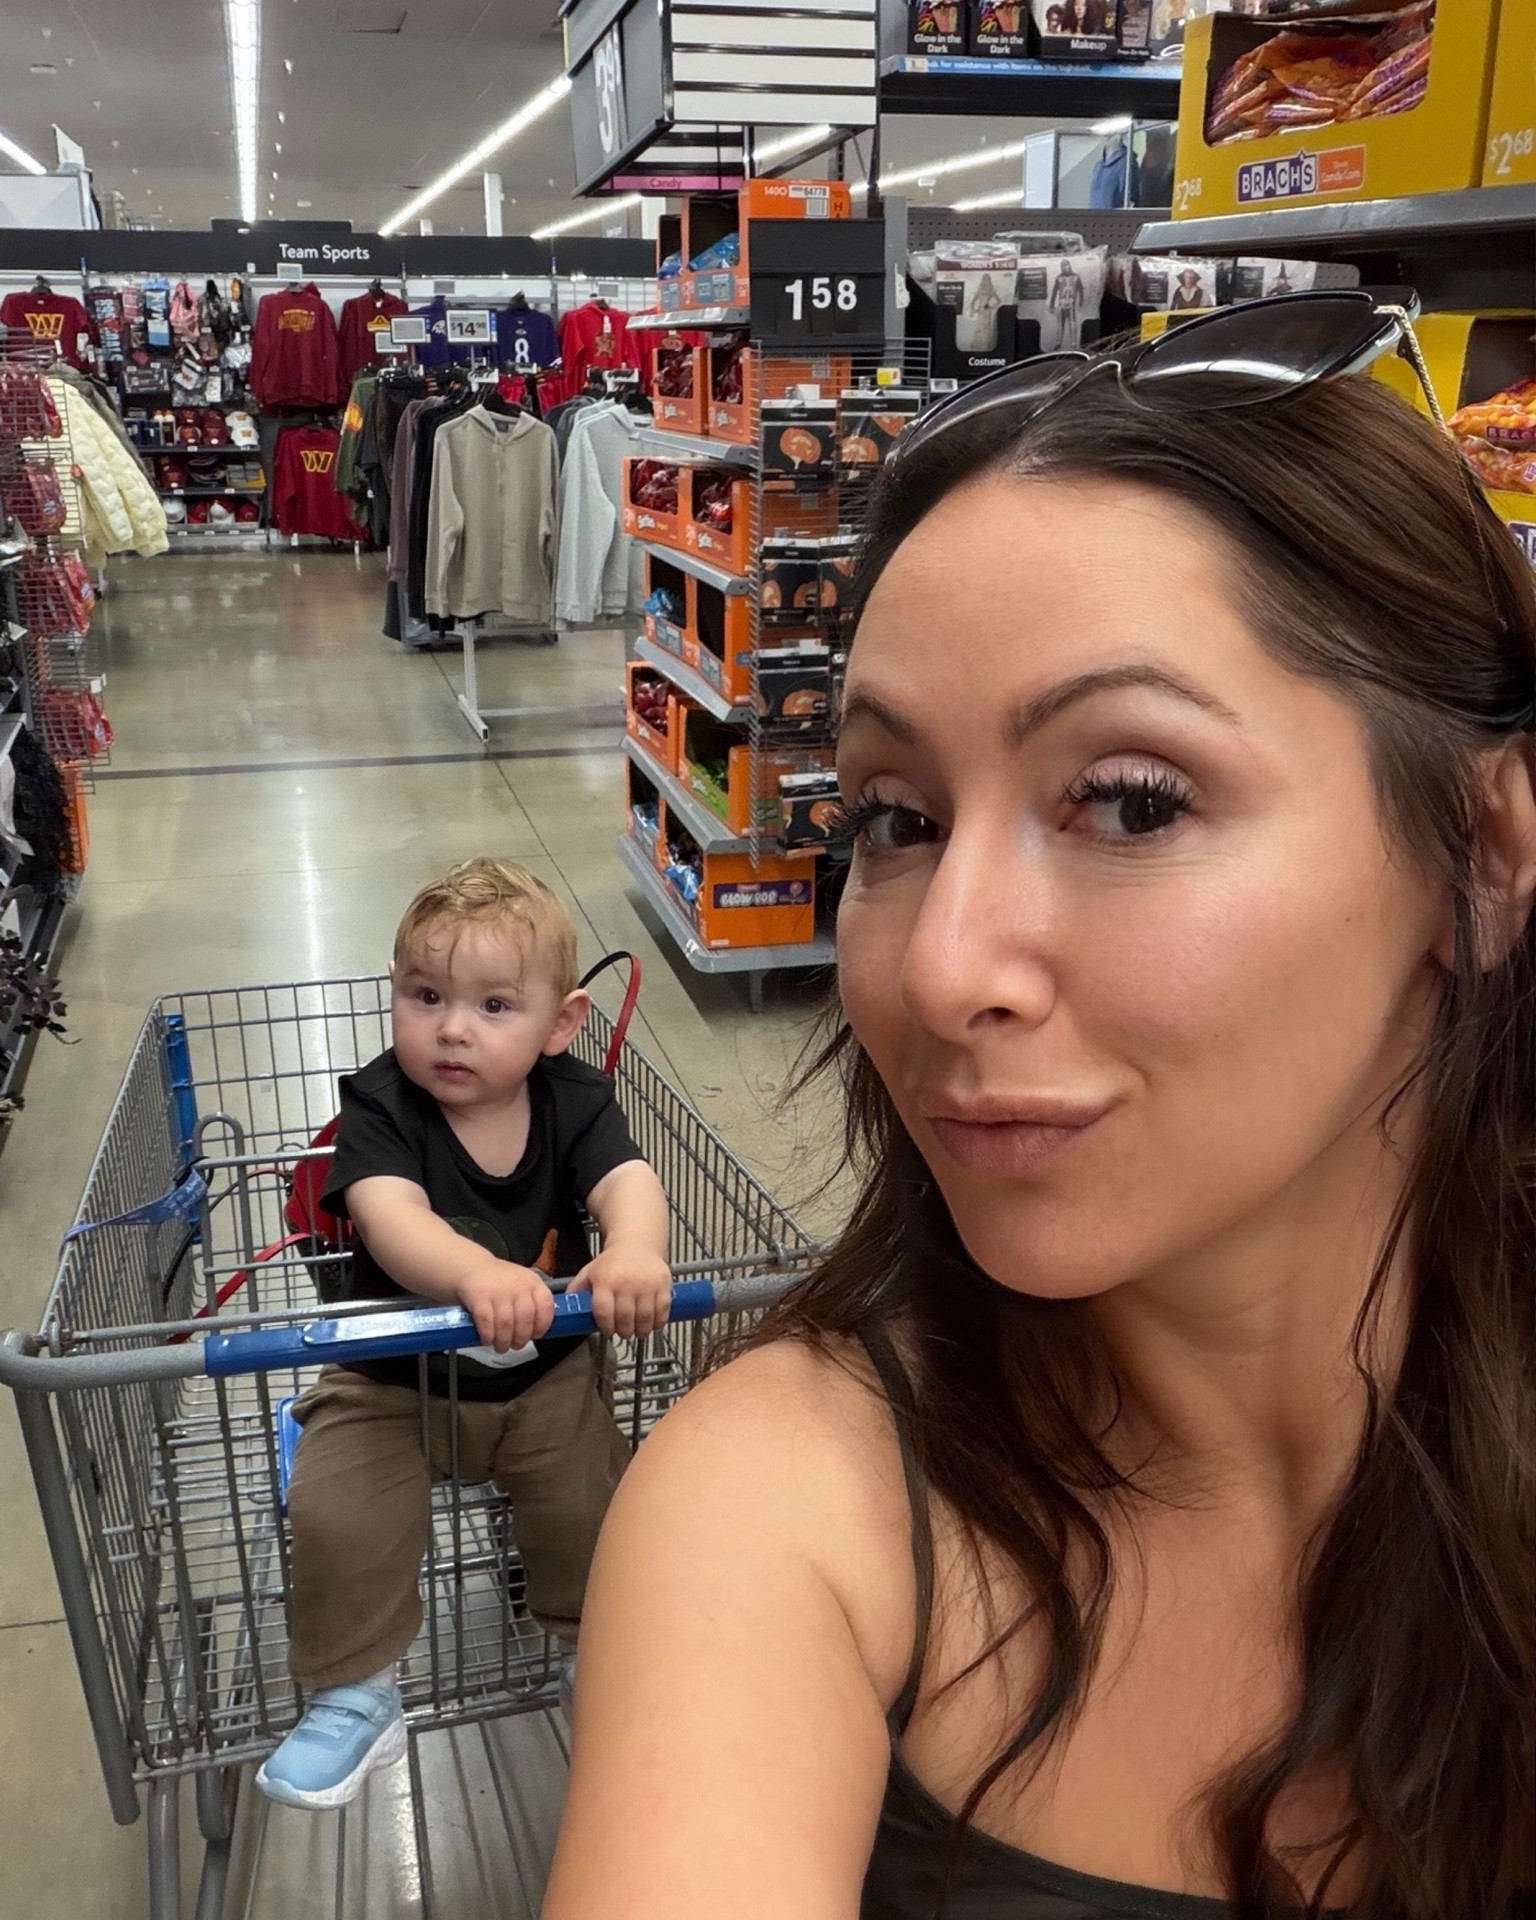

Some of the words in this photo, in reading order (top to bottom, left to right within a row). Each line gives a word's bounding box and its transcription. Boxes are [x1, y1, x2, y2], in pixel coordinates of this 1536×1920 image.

[914, 34, 936, 43] Glow
[937, 34, 946, 43] in
[947, 34, 962, 44] the
[977, 34, 999, 44] Glow
[1000, 34, 1009, 44] in
[1010, 35, 1025, 45] the
[927, 44, 948, 53] Dark
[989, 45, 1010, 54] Dark
[1070, 39, 1107, 52] Makeup
[649, 177, 682, 190] Candy
[279, 243, 319, 259] Team
[322, 244, 370, 264] Sports
[514, 338, 529, 363] 8
[968, 356, 1006, 367] Costume
[1487, 427, 1536, 441] BRAC
[300, 450, 335, 473] W
[414, 1314, 446, 1325] store
